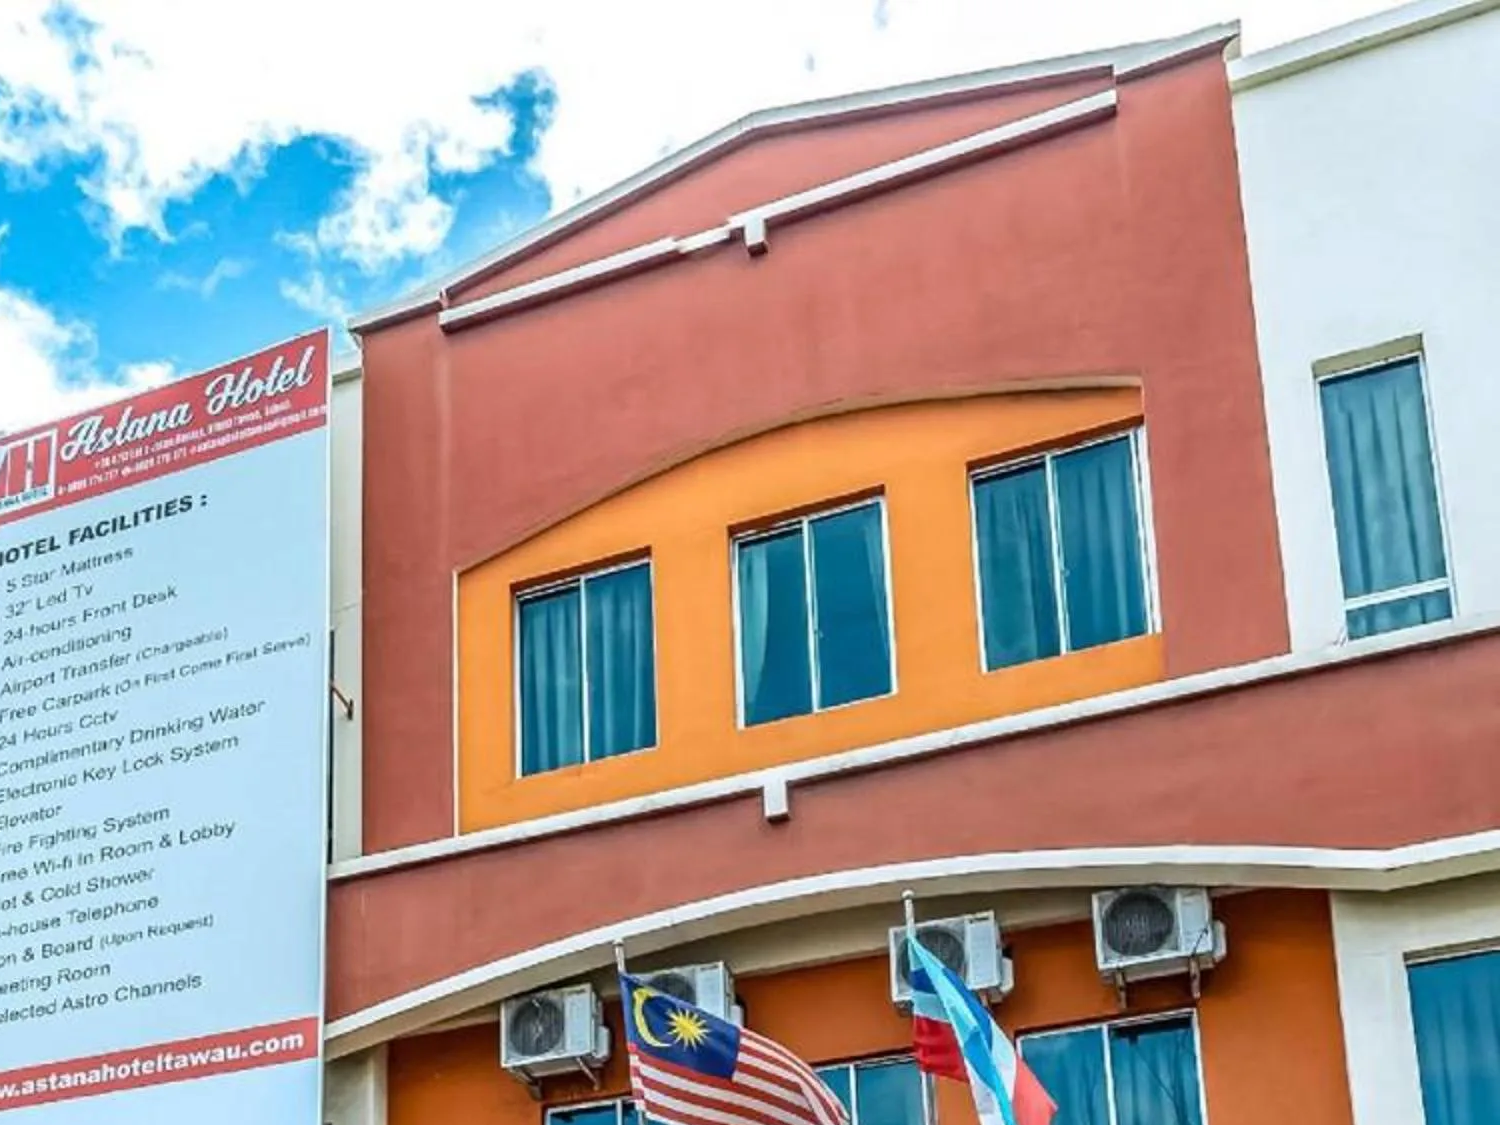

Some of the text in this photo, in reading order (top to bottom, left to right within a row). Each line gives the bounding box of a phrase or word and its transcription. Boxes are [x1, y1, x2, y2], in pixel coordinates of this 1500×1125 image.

[60, 401, 193, 461] Astana
[205, 345, 315, 415] Hotel
[68, 500, 193, 546] FACILITIES
[6, 547, 133, 593] 5 Star Mattress
[2, 585, 178, 645] 24-hours Front Desk
[35, 590, 68, 613] Led
[72, 583, 94, 603] Tv
[1, 625, 132, 670] Air-conditioning
[0, 670, 56, 698] Airport
[60, 651, 131, 681] Transfer
[0, 704, 37, 723] Free
[42, 682, 112, 714] Carpark
[144, 667, 176, 688] First
[180, 657, 222, 677] Come
[225, 646, 258, 666] First
[262, 632, 311, 656] Serve)
[22, 719, 73, 743] Hours
[79, 709, 118, 731] Cctv
[130, 713, 204, 745] Drinking
[209, 699, 266, 725] Water
[83, 764, 117, 787] Key
[122, 750, 164, 774] Lock
[170, 734, 239, 765] System
[28, 824, 97, 852] Fighting
[103, 808, 170, 834] System
[33, 854, 74, 876] Wi-fi
[100, 837, 154, 864] Room
[158, 832, 173, 848] &
[179, 820, 236, 848] Lobby
[21, 890, 36, 906] &
[41, 880, 81, 903] Cold
[86, 867, 156, 893] Shower
[67, 895, 159, 926] Telephone
[21, 947, 36, 963] &
[41, 936, 94, 960] Board
[100, 929, 143, 952] (Upon
[147, 914, 214, 940] Request)
[57, 962, 111, 984] Room
[61, 990, 108, 1012] Astro
[114, 973, 202, 1002] Channels
